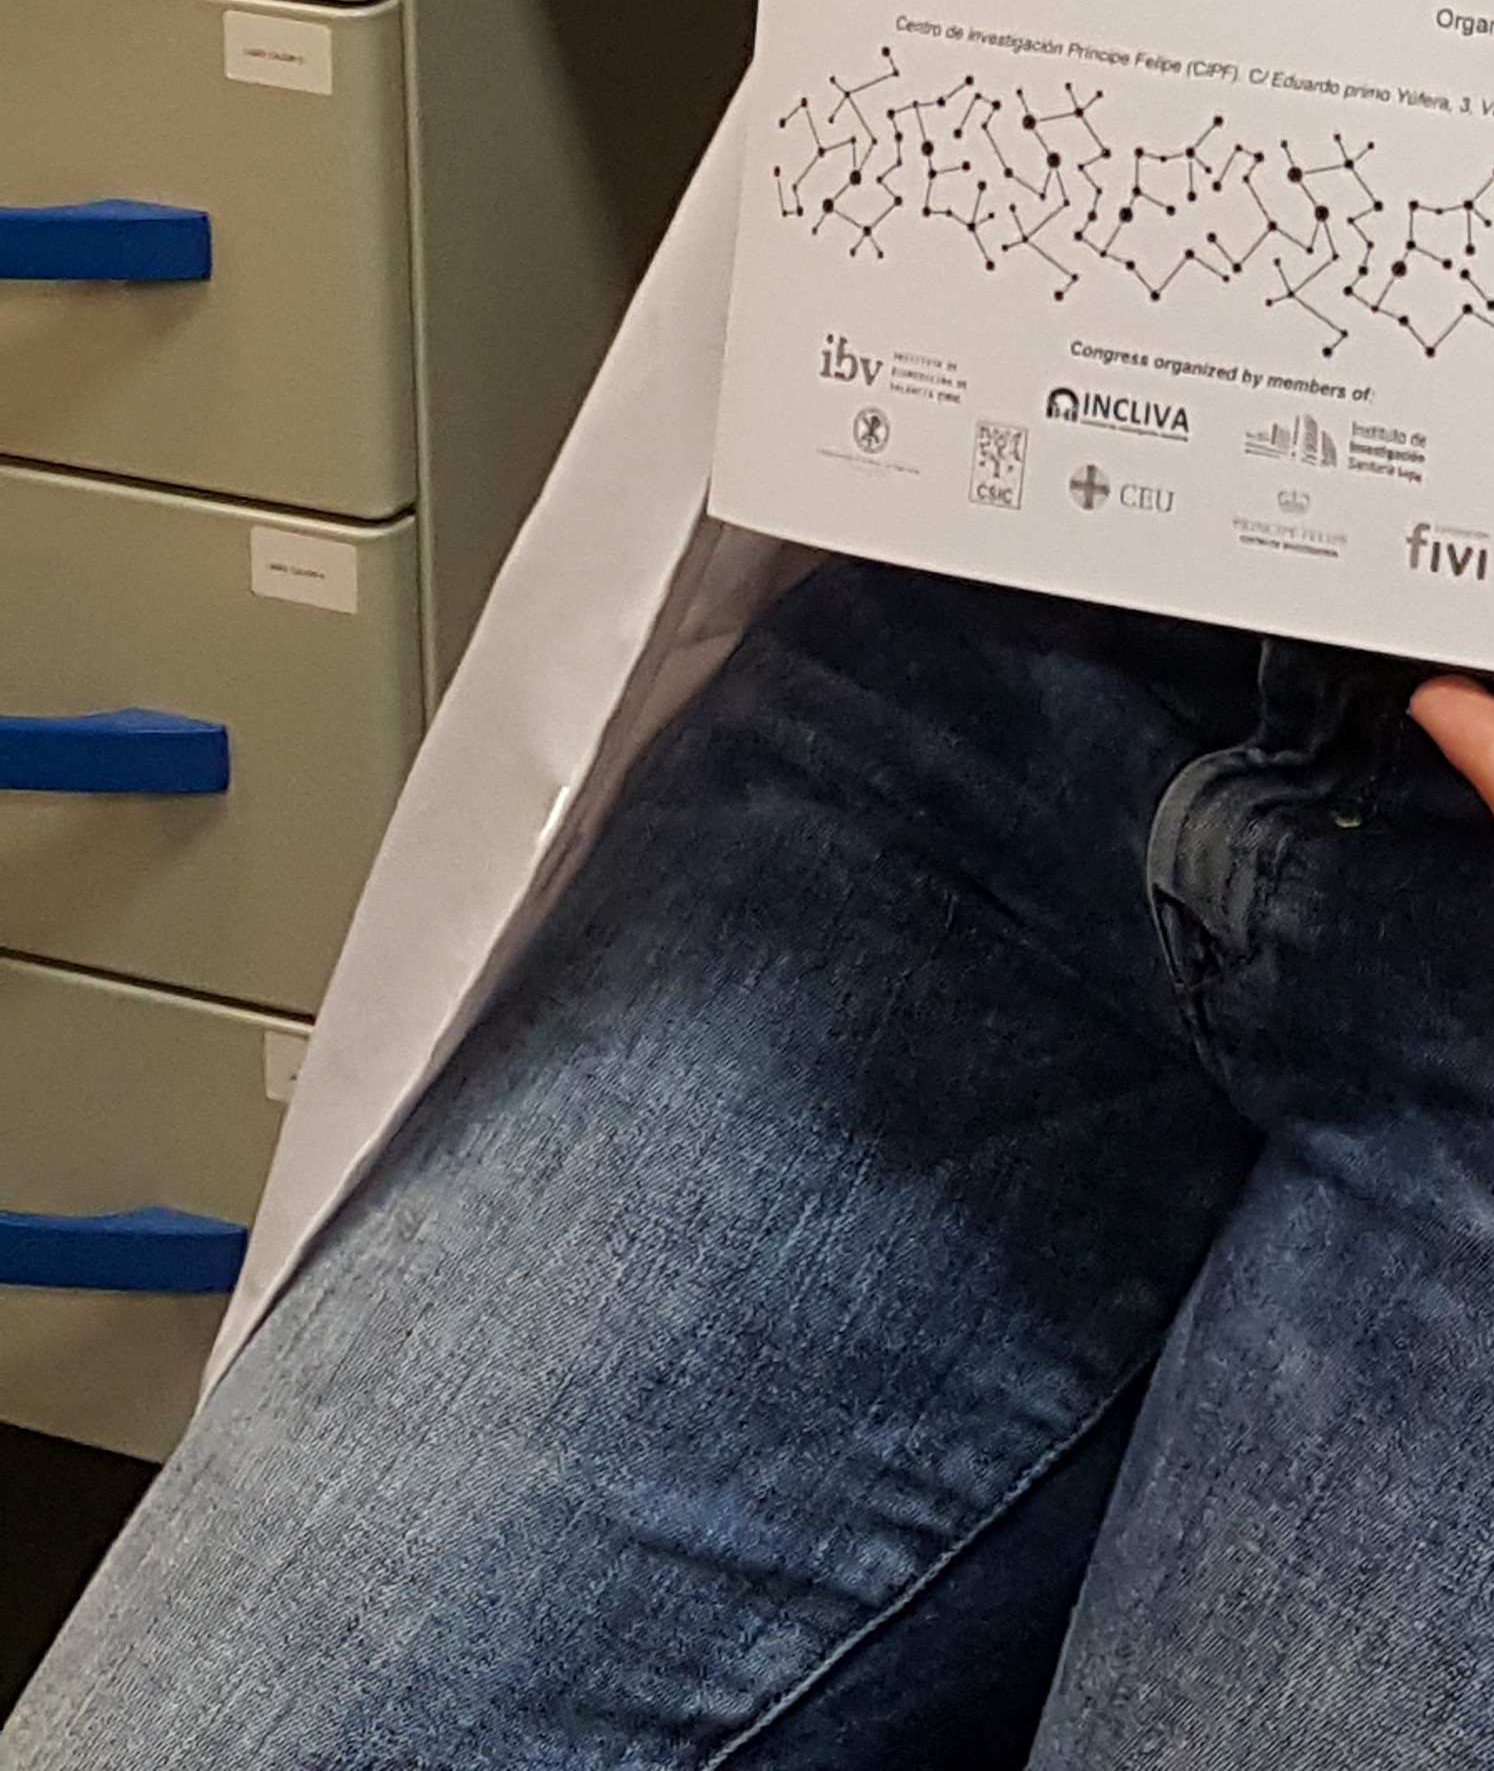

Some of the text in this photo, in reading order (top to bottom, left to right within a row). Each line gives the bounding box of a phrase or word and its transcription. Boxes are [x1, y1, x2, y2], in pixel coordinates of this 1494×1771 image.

[819, 333, 884, 387] ibv
[1069, 340, 1149, 367] Congress
[1153, 356, 1238, 381] organized
[1241, 368, 1263, 389] by
[1266, 375, 1346, 399] members
[1082, 393, 1190, 433] INCLIVA
[976, 483, 1013, 505] CSIC
[1119, 483, 1177, 514] CEU
